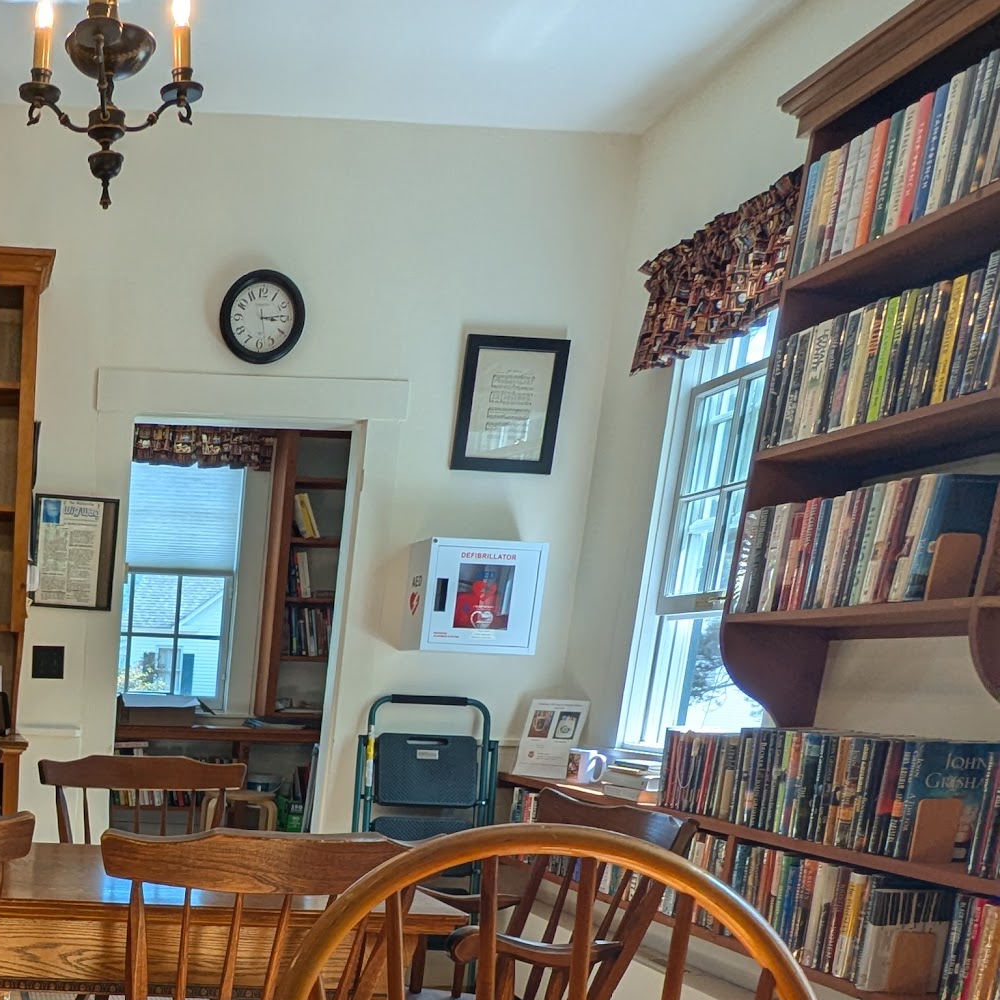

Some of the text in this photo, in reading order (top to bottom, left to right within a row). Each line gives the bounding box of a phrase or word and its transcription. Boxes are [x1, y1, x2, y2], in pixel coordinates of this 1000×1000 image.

[920, 113, 941, 189] TANA FRENCH
[903, 121, 924, 197] TANA FRENCH
[875, 137, 896, 211] TANA FRENCH
[248, 291, 256, 302] 11
[259, 288, 268, 298] 12
[272, 292, 278, 301] 1
[976, 277, 993, 320] GARWOOD
[238, 299, 248, 310] 10
[278, 301, 287, 311] 2
[941, 281, 961, 354] LISA GARDNER
[235, 325, 245, 335] 8
[867, 318, 882, 357] ALONE
[245, 335, 252, 343] 7
[256, 339, 263, 349] 6
[268, 336, 275, 346] 5
[816, 328, 830, 365] LETHAL
[810, 334, 824, 372] WHITE
[461, 552, 517, 561] DEFIBRILLATOR
[412, 575, 422, 588] AED
[756, 741, 768, 768] BROKER
[945, 752, 988, 770] JOHN
[925, 772, 986, 790] GRISHA
